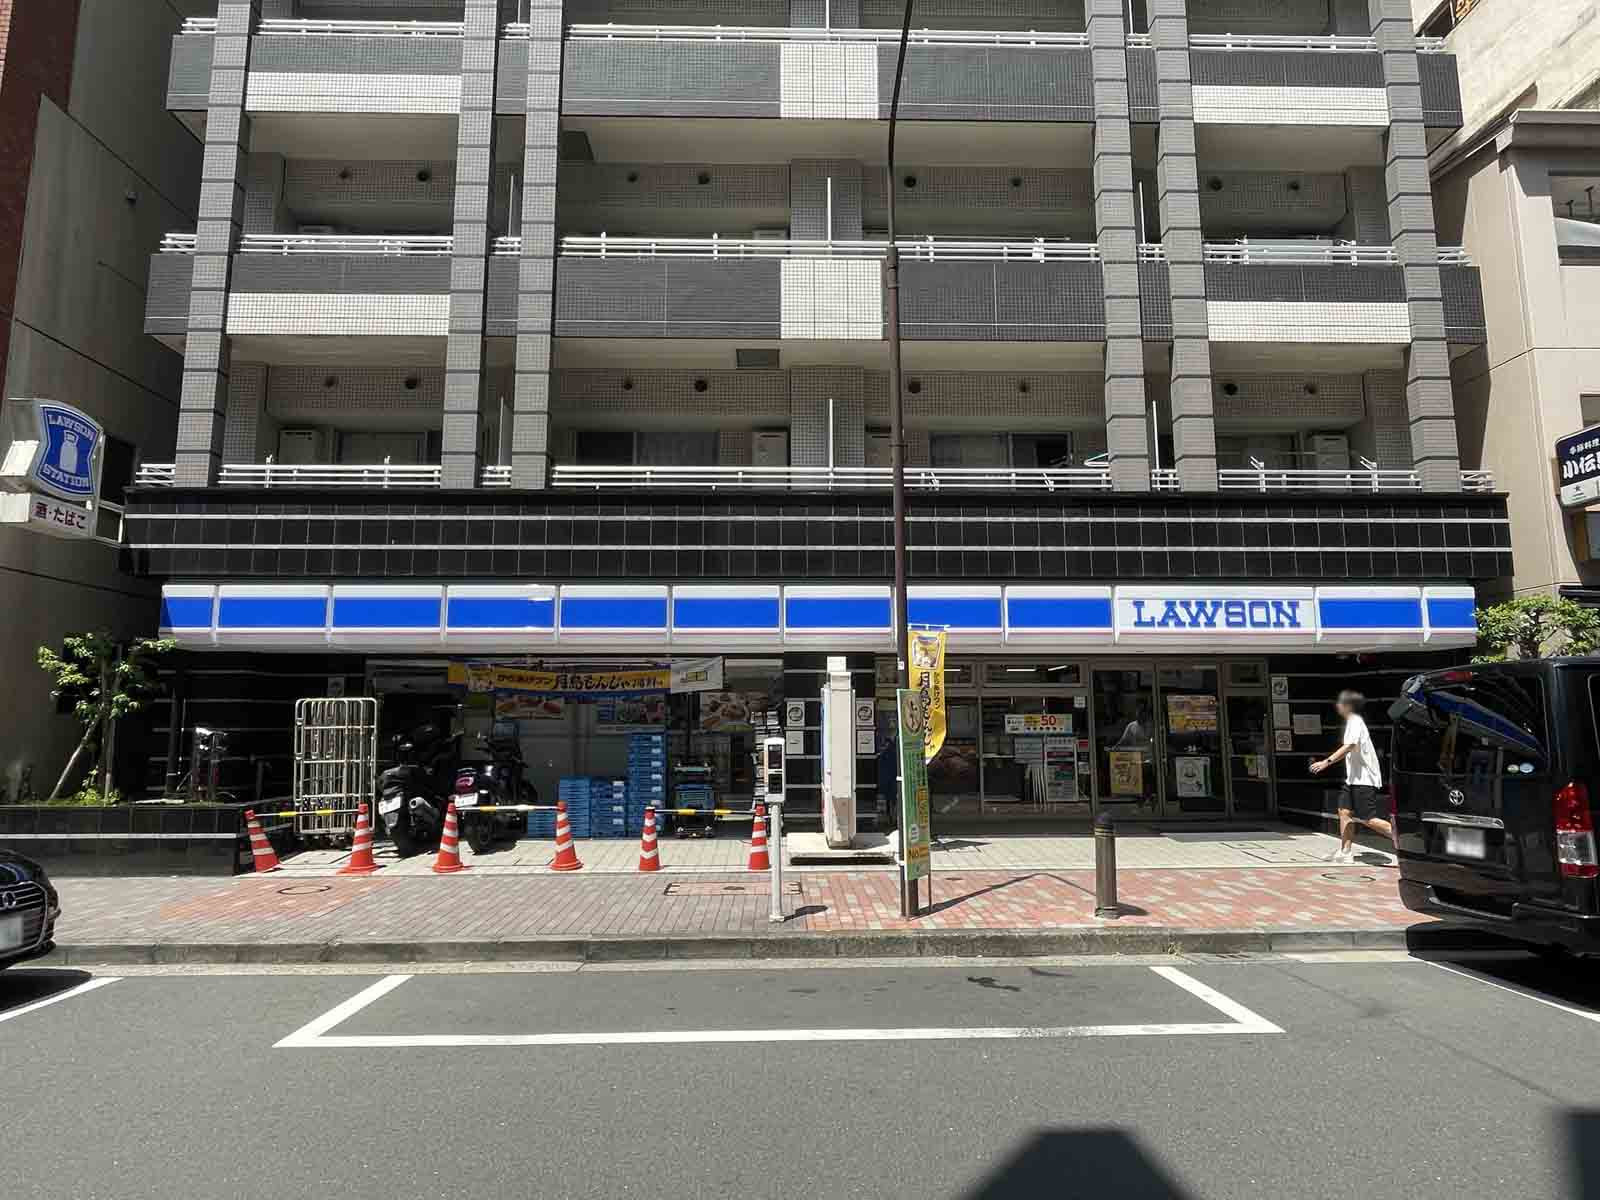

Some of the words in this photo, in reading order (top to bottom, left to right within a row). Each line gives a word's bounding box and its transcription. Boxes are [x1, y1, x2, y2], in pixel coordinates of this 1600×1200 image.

[48, 414, 94, 441] LAWSON
[42, 463, 90, 488] STATION
[1133, 600, 1301, 628] LAWSON
[1041, 715, 1057, 726] 50
